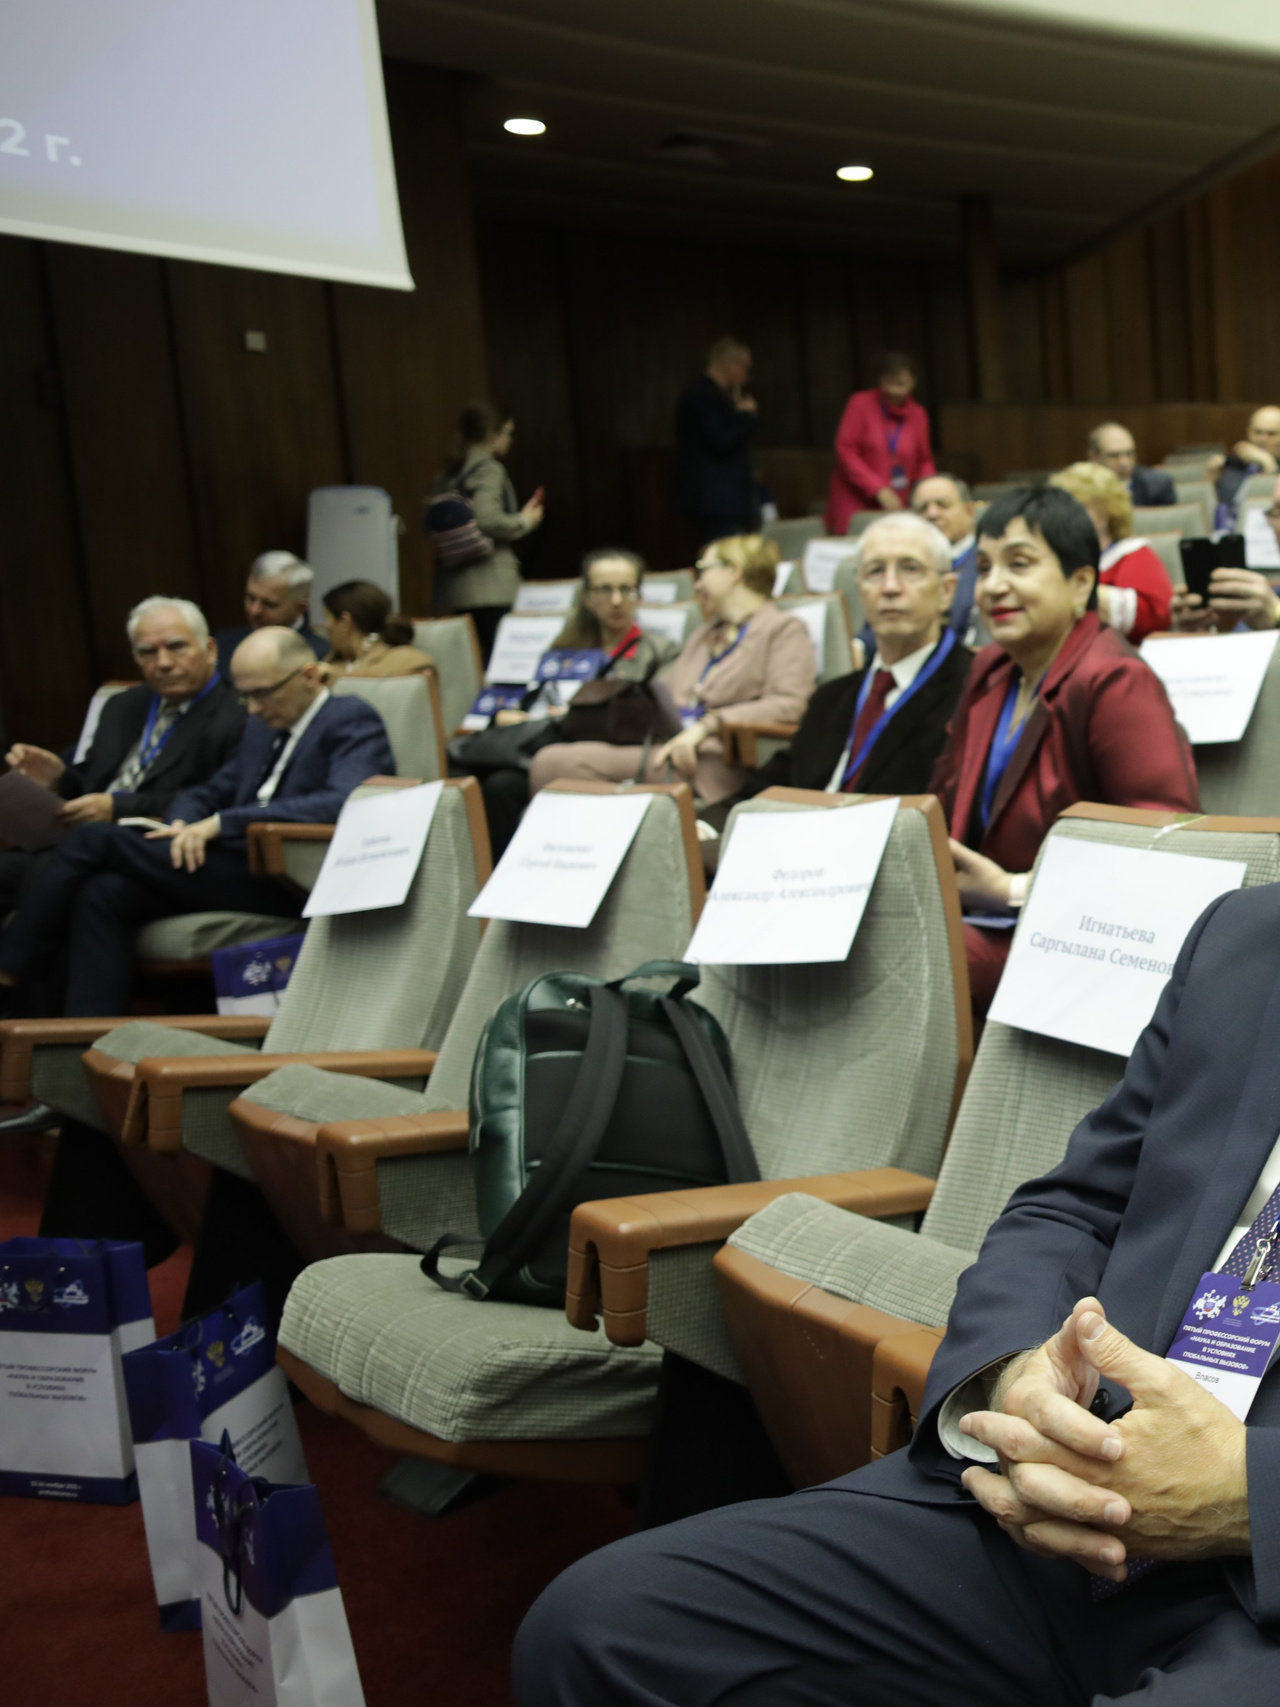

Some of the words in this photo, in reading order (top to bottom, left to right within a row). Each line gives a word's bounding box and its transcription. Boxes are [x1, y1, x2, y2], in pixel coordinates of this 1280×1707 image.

[45, 133, 82, 167] г.
[1078, 915, 1155, 944] Игнатьева
[1029, 931, 1106, 961] Саргылана
[1195, 1371, 1219, 1384] Власов
